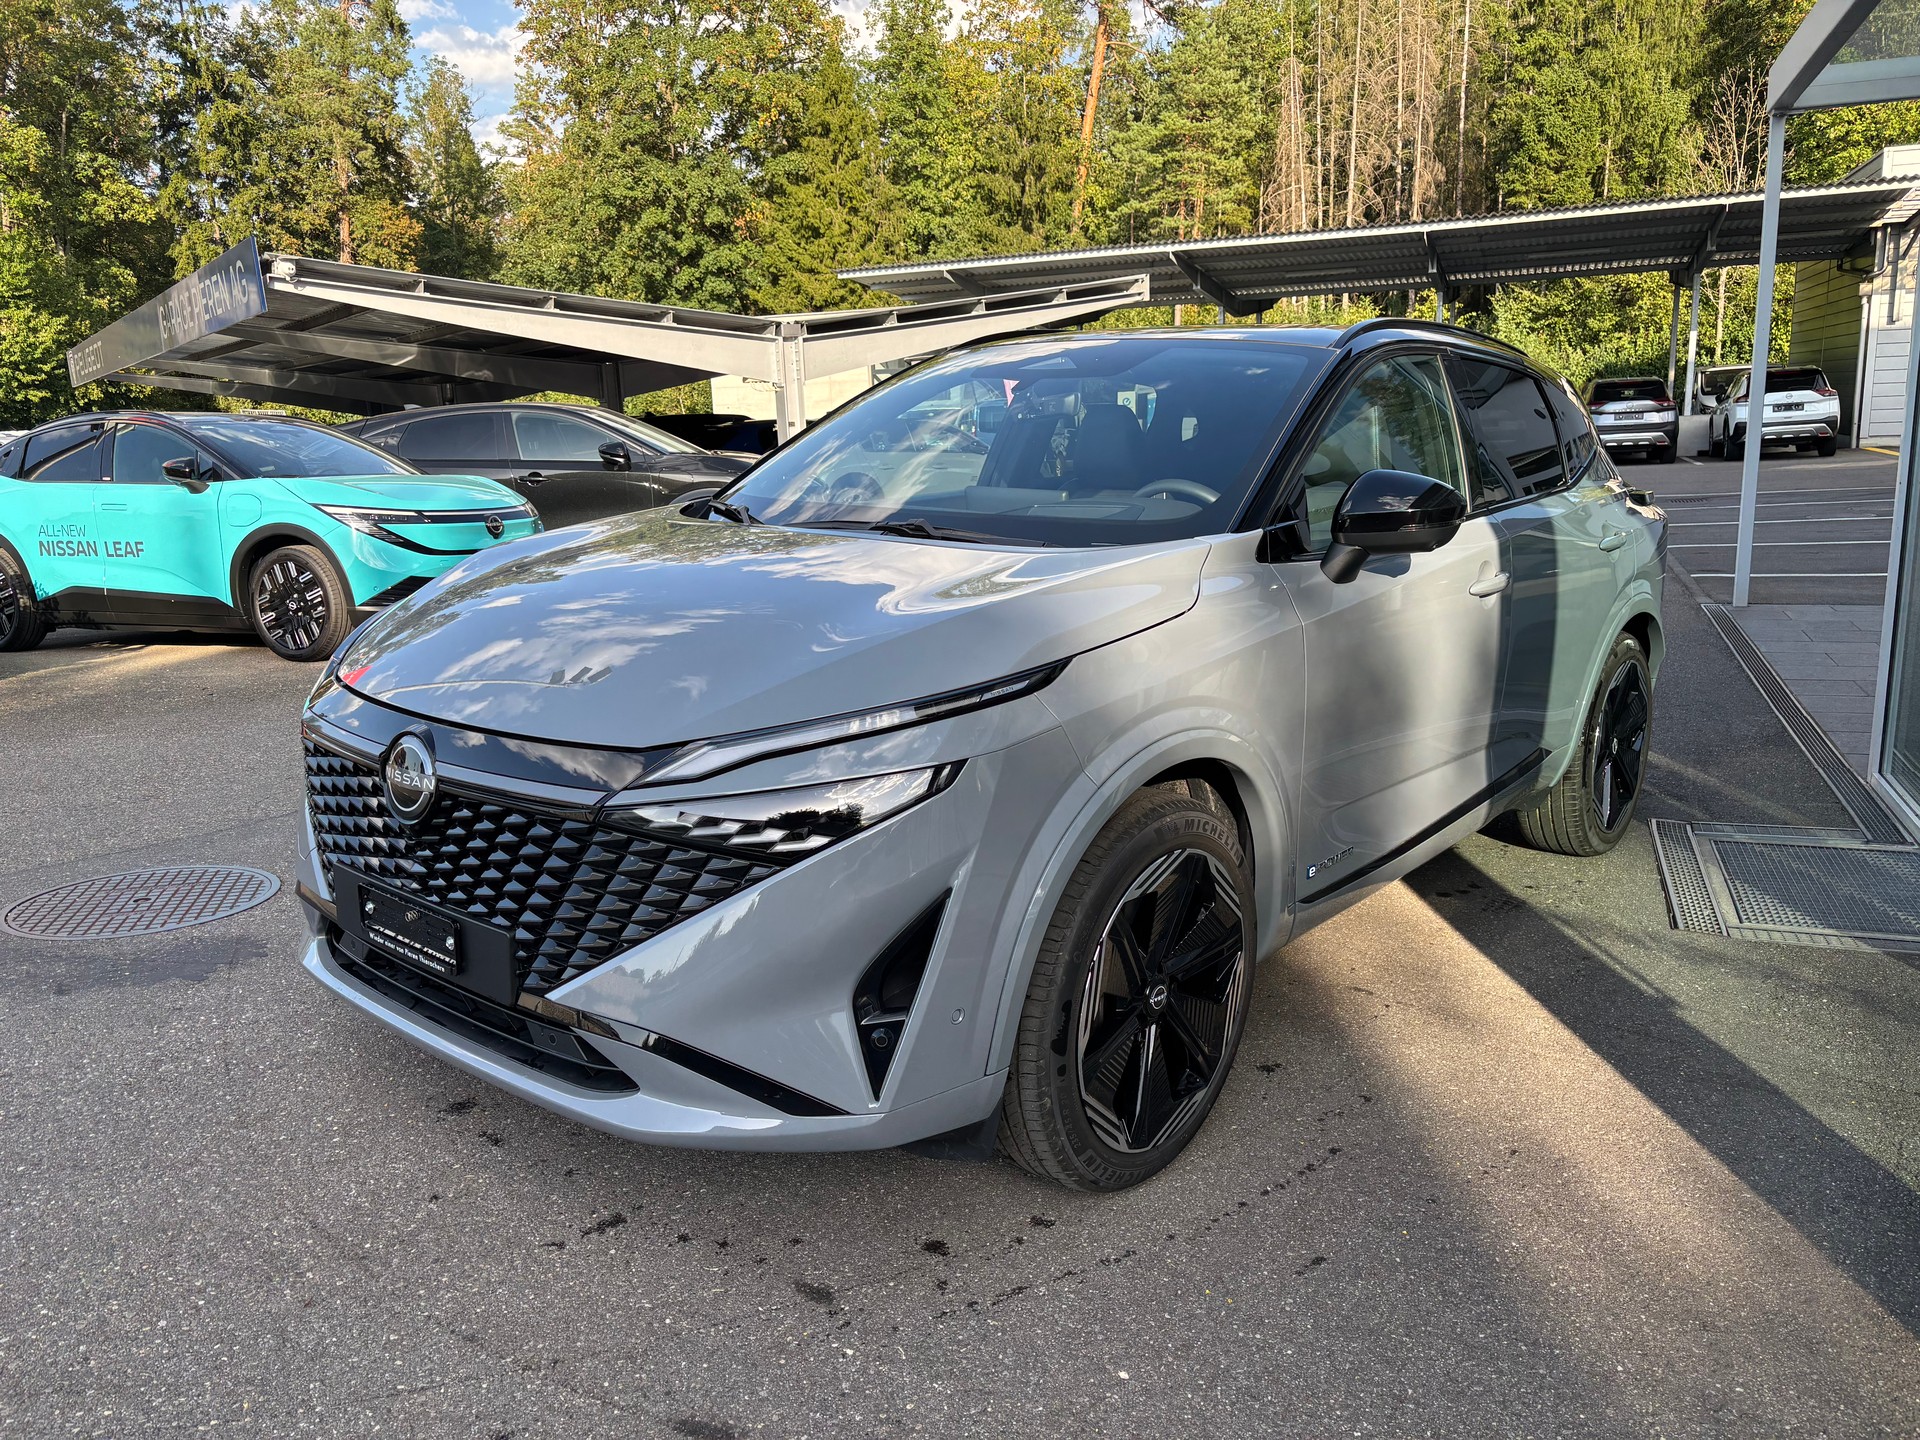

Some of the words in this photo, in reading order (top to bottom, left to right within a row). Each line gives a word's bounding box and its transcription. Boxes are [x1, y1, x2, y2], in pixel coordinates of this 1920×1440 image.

[159, 291, 194, 339] GARAGE
[191, 270, 231, 324] PIEREN
[229, 259, 249, 308] AG
[38, 524, 86, 537] ALL-NEW
[38, 540, 99, 557] NISSAN
[104, 541, 145, 558] LEAF
[386, 765, 435, 790] NISSAN
[1183, 818, 1245, 869] MICHELIN
